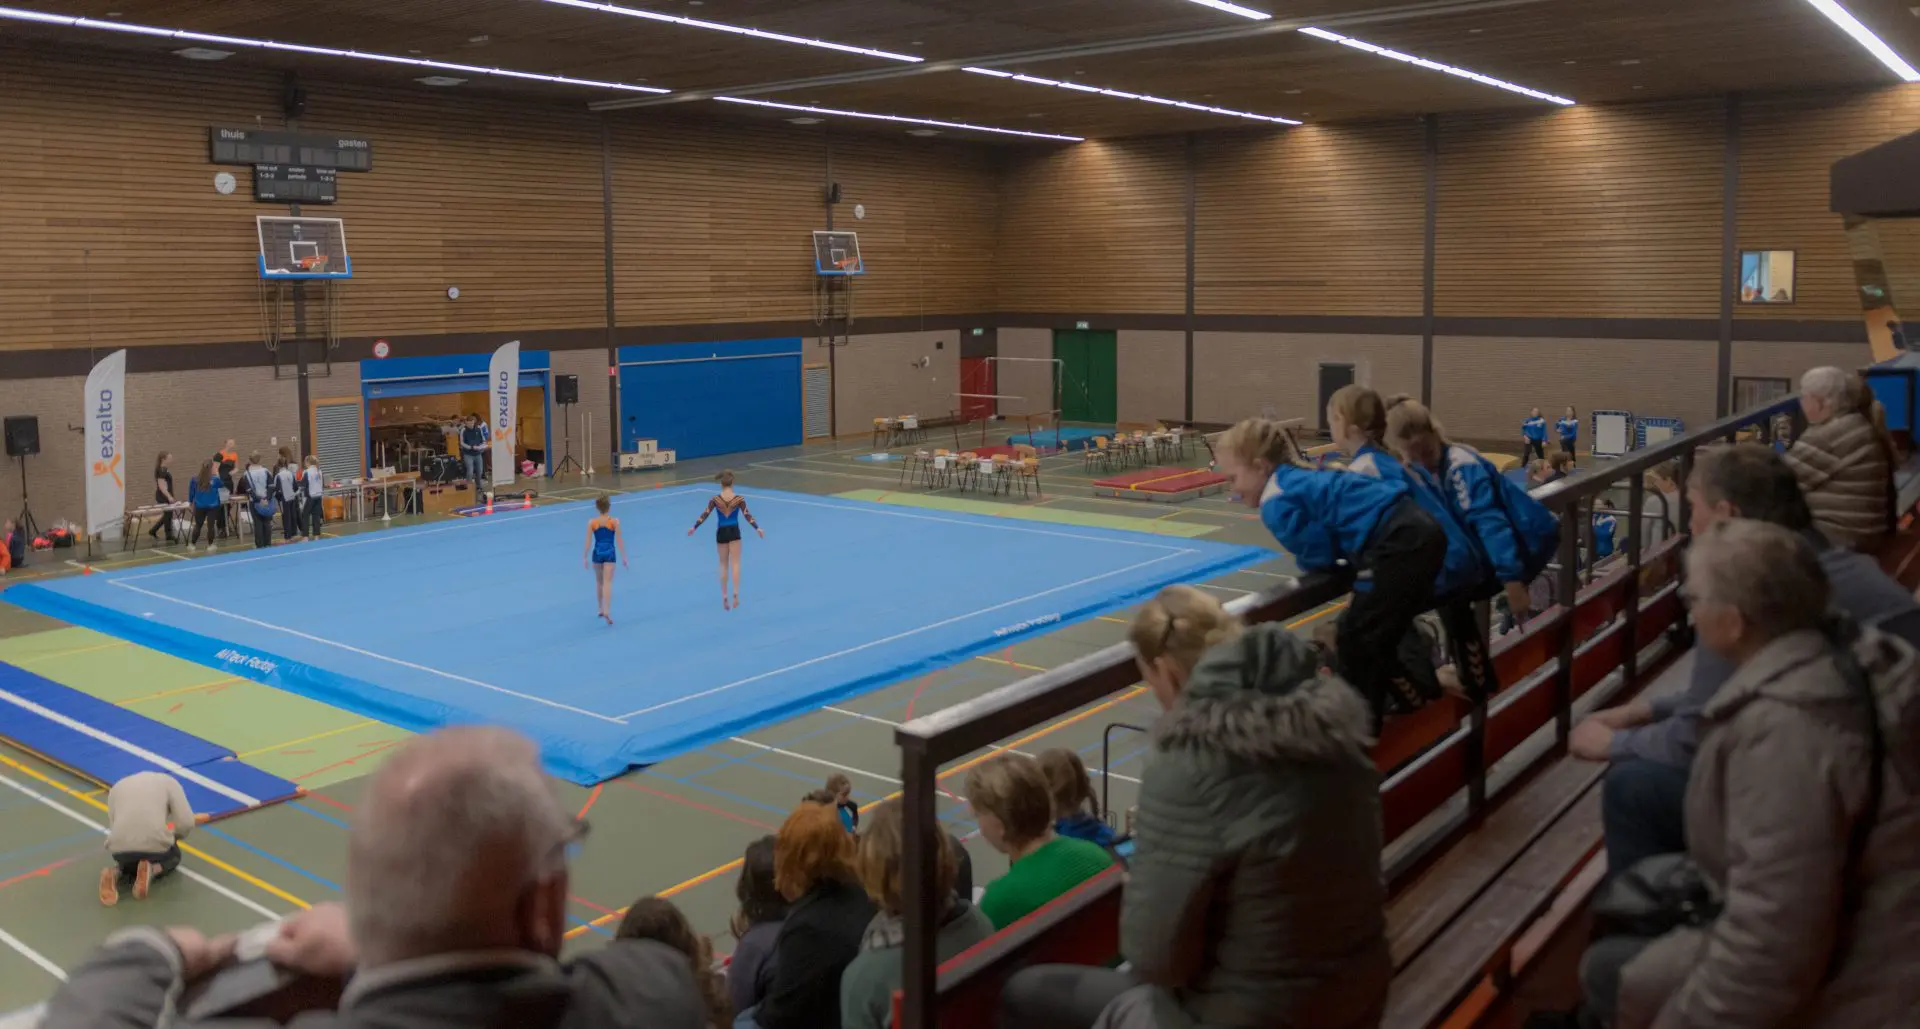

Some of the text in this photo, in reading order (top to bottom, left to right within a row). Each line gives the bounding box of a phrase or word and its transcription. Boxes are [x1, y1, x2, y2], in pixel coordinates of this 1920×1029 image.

[220, 128, 245, 140] thuis
[338, 139, 368, 149] gasten
[497, 370, 508, 428] exalto
[96, 390, 113, 458] exalto
[646, 443, 650, 452] 1
[628, 456, 634, 465] 2
[664, 453, 670, 462] 3
